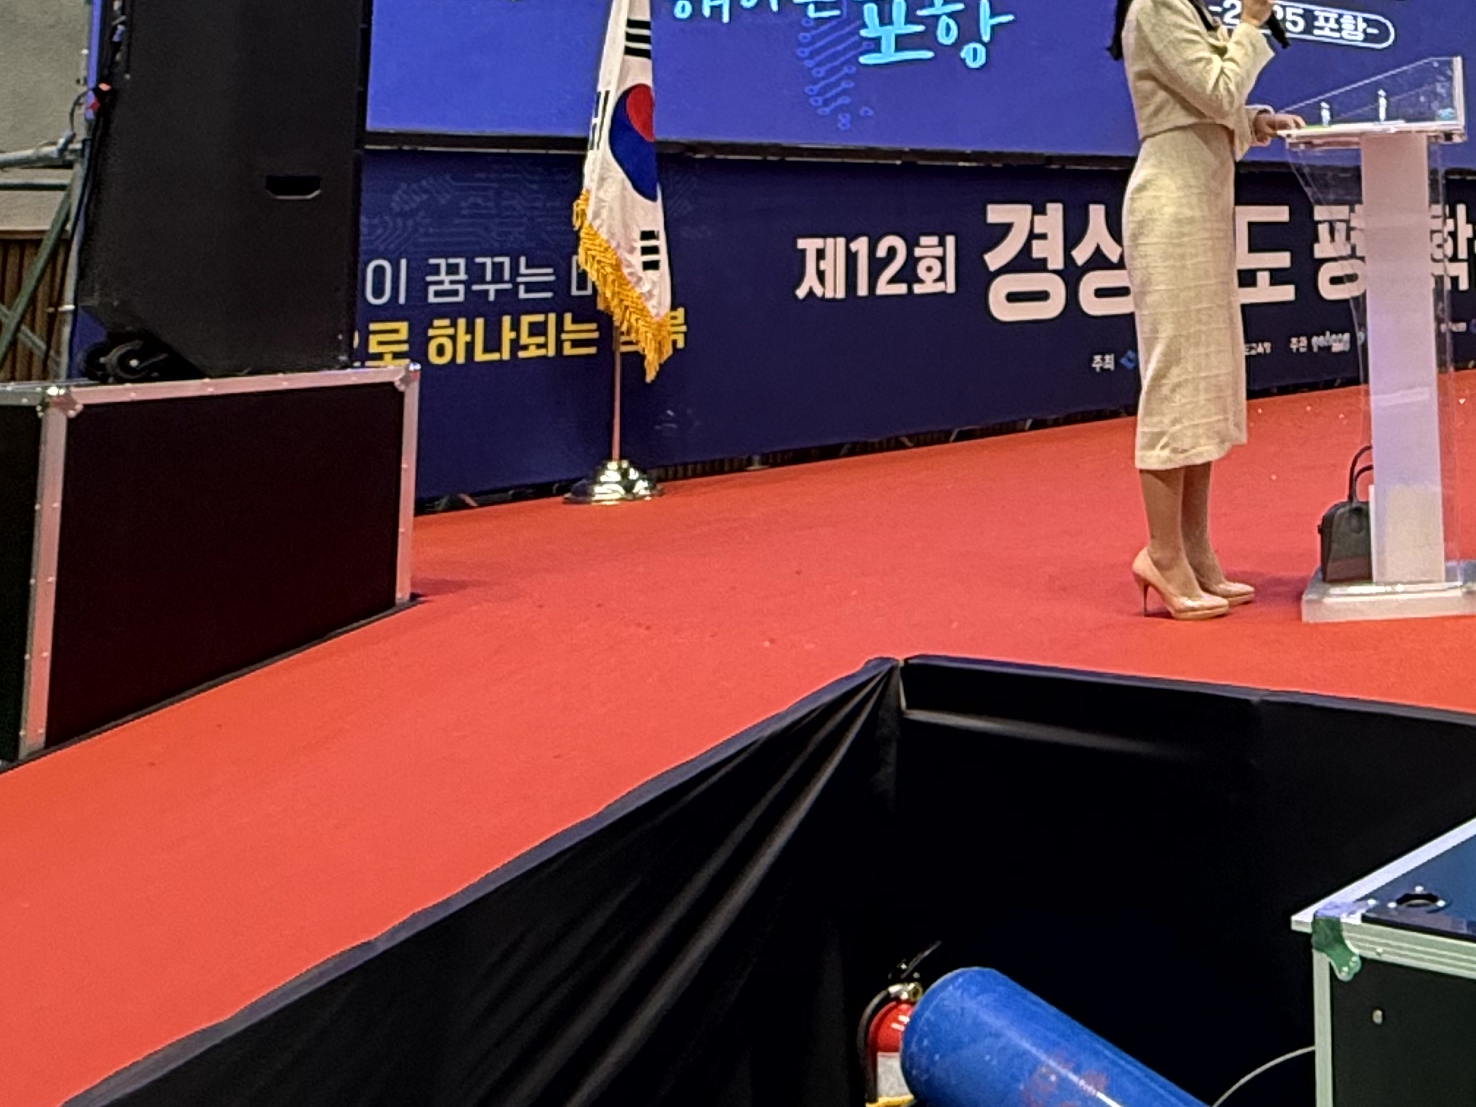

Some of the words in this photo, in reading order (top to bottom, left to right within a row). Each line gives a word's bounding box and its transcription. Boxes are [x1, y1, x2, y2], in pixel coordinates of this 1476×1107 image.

[425, 255, 557, 304] 꿈꾸는
[795, 234, 956, 302] 제12회
[982, 202, 1296, 323] 경상도
[427, 311, 601, 365] 하나되는
